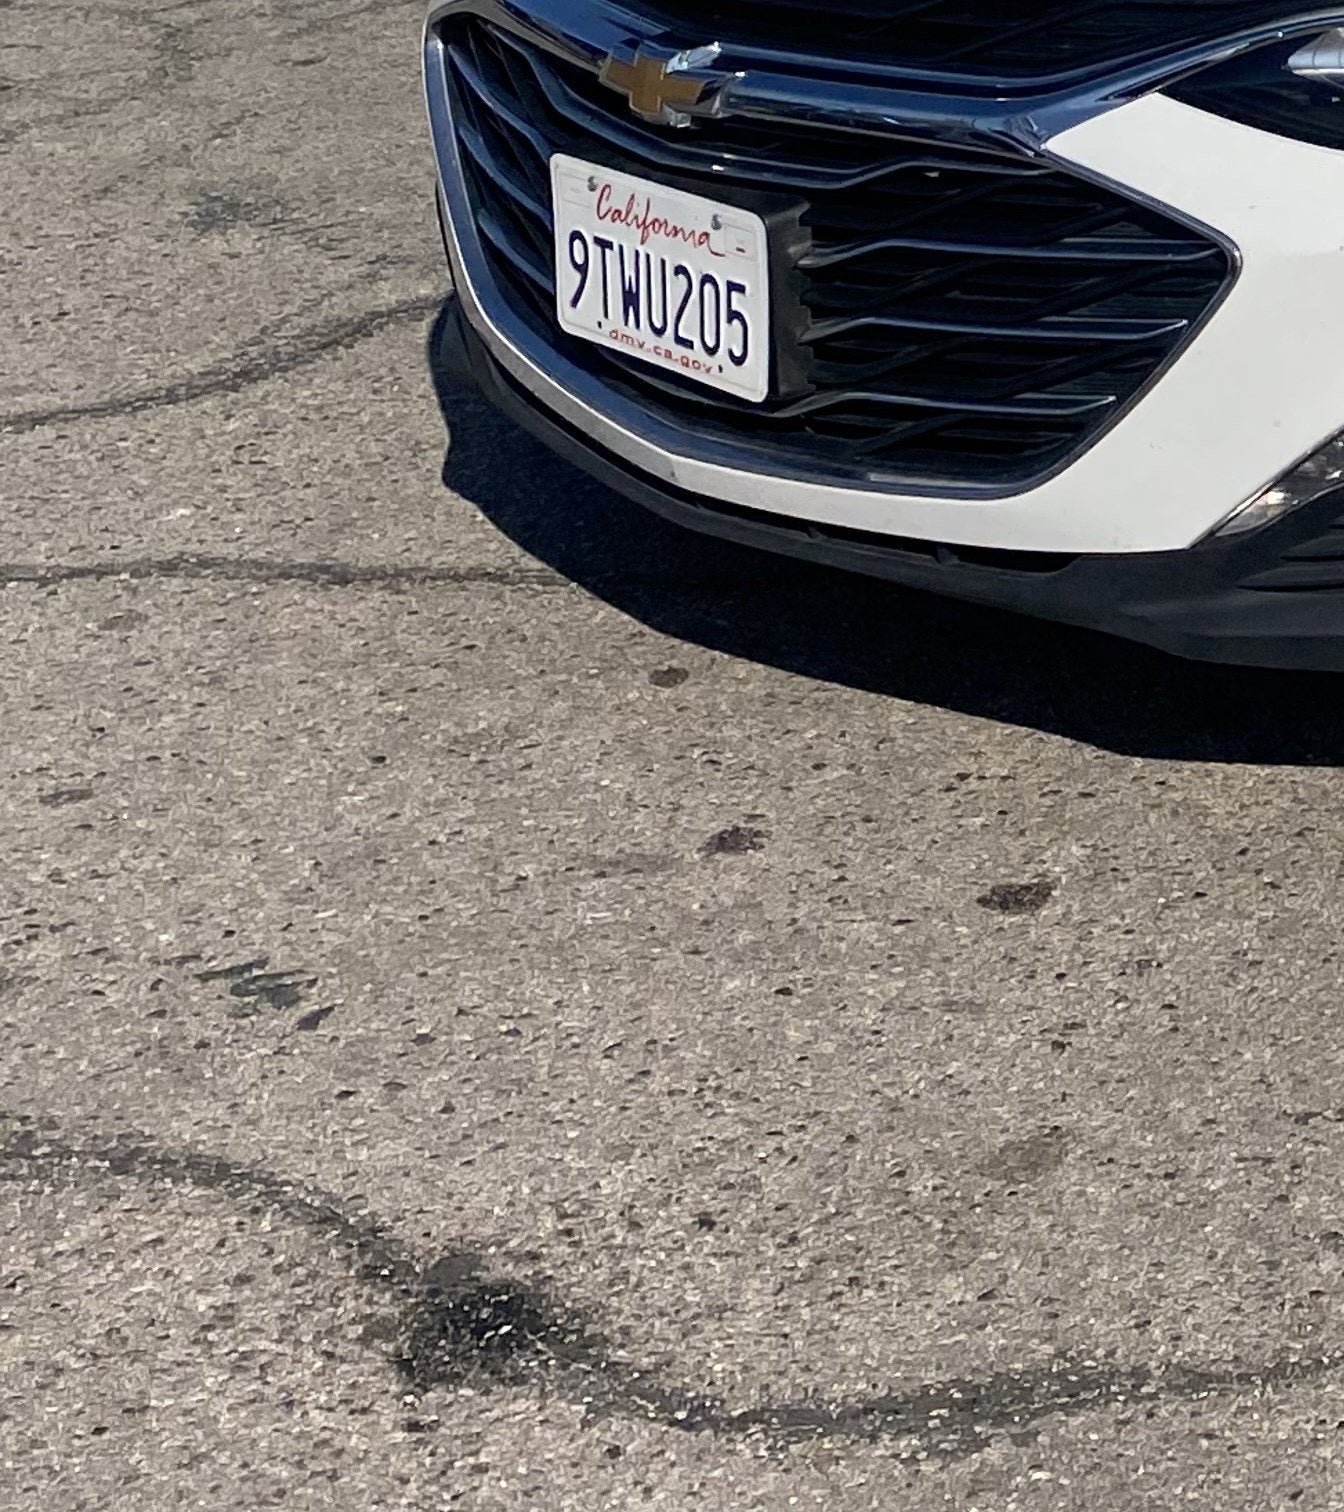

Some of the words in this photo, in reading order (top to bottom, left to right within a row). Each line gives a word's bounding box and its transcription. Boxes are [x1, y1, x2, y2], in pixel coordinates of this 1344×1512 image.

[595, 183, 726, 258] California
[567, 229, 750, 367] 9TWU205
[608, 328, 714, 375] dmv.ca.gov
